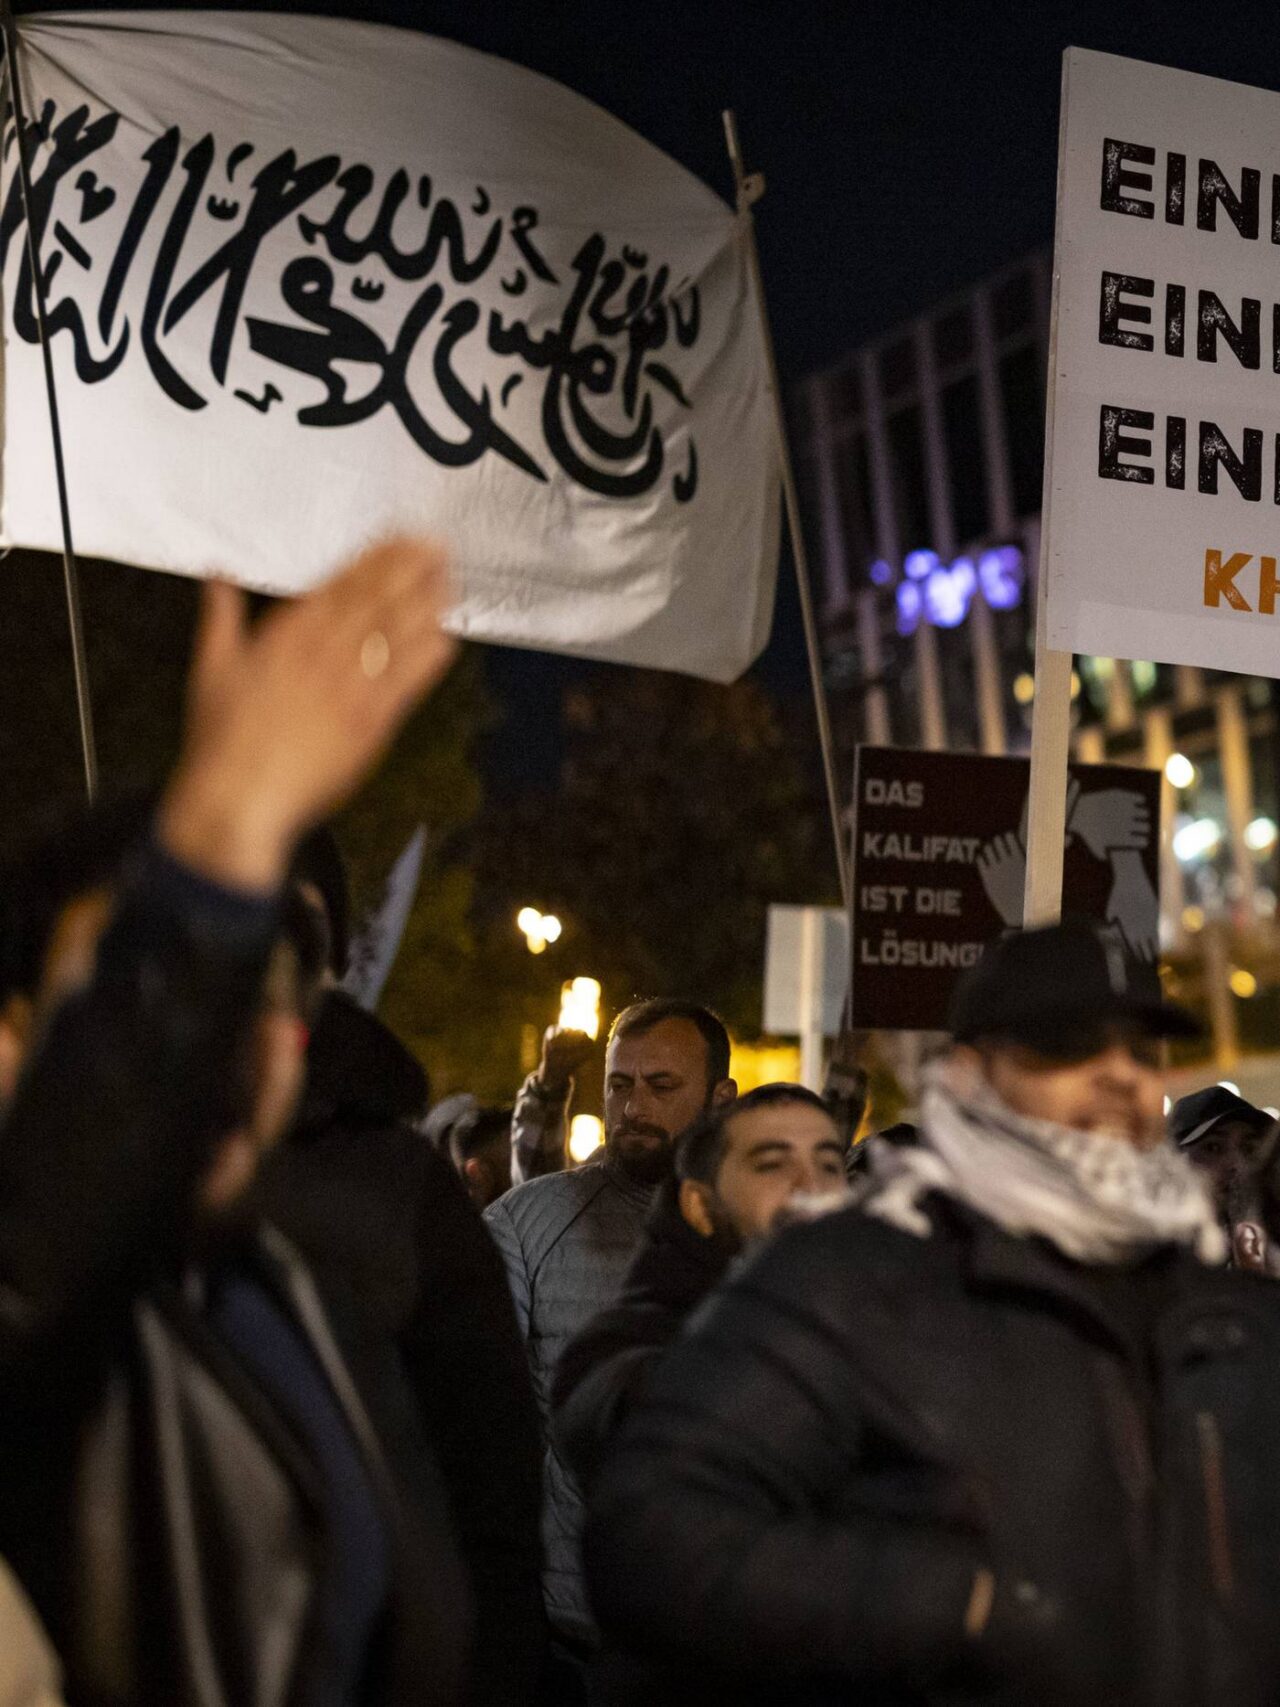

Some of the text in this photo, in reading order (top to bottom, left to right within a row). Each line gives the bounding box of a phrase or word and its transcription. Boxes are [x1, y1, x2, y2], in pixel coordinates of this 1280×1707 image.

[865, 779, 924, 808] DAS
[863, 832, 979, 864] KALIFAT
[861, 886, 963, 916] IST DIE
